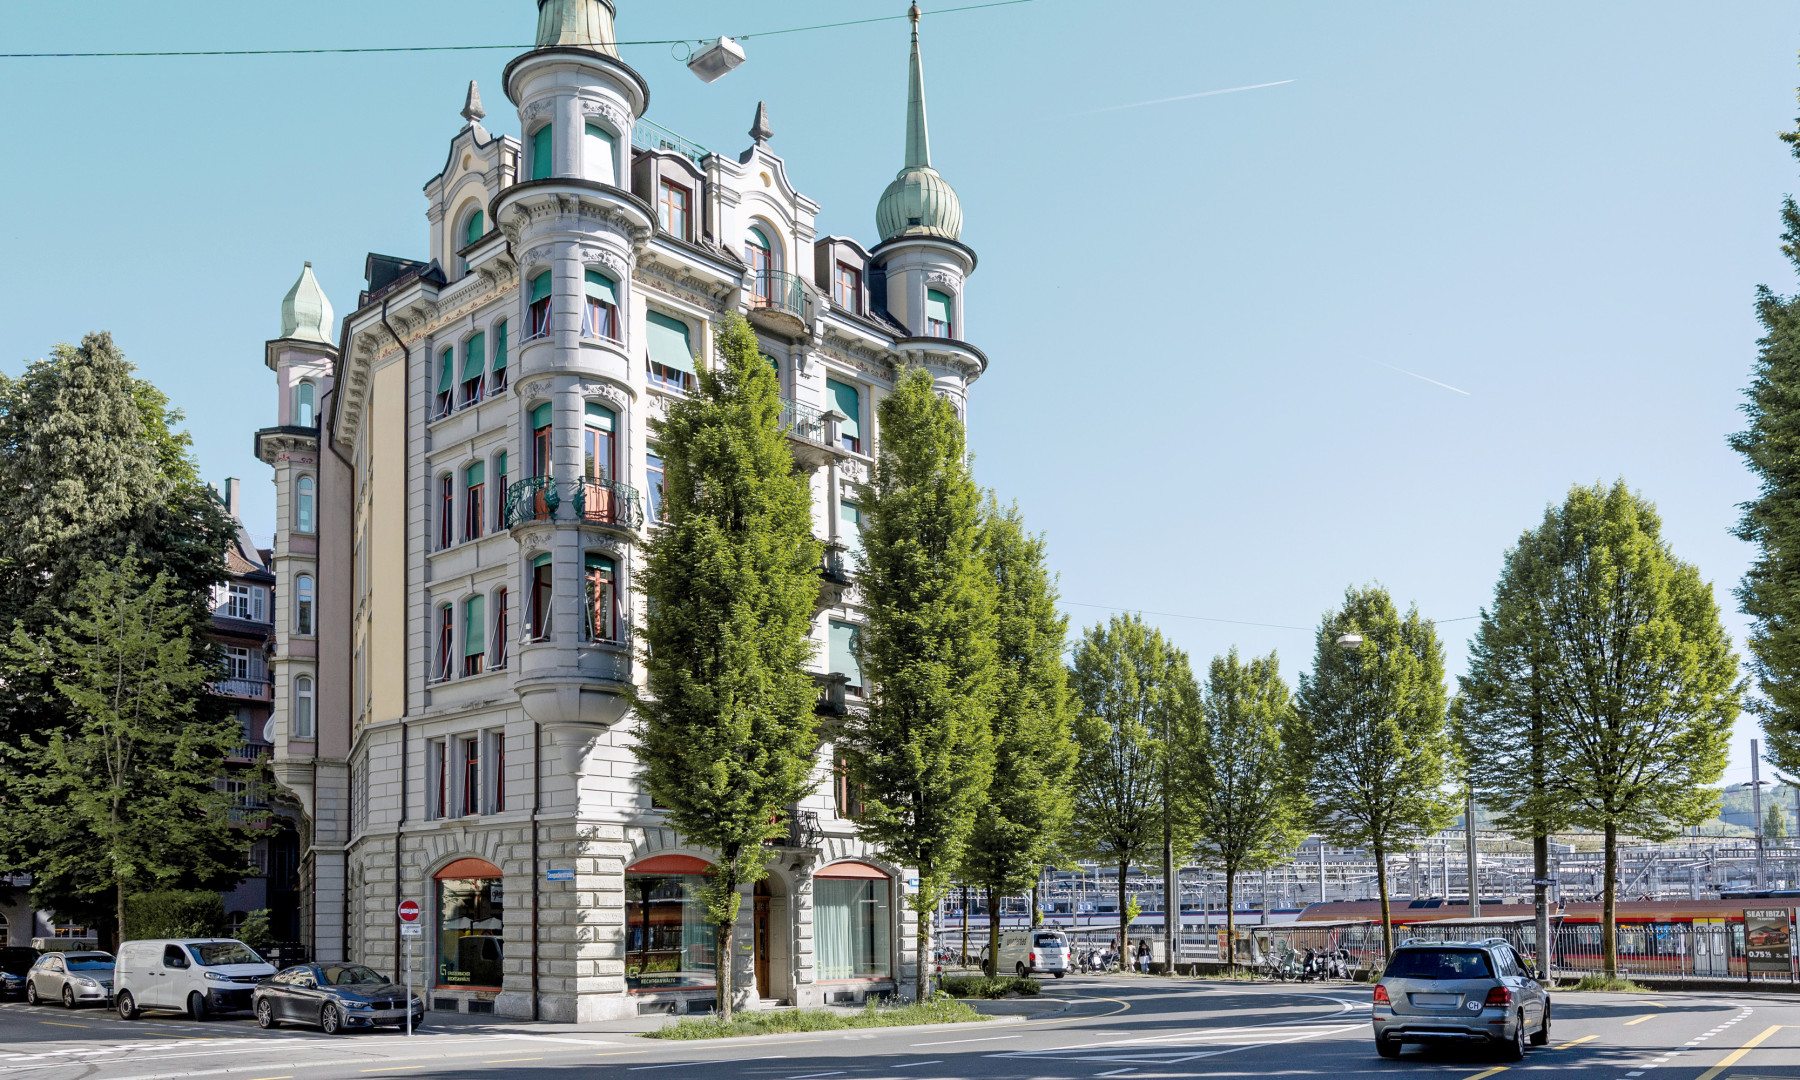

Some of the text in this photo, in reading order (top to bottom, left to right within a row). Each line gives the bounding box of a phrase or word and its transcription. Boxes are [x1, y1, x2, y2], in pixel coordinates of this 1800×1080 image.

[1746, 910, 1786, 918] SEAT IBIZA
[1468, 1001, 1479, 1009] CH
